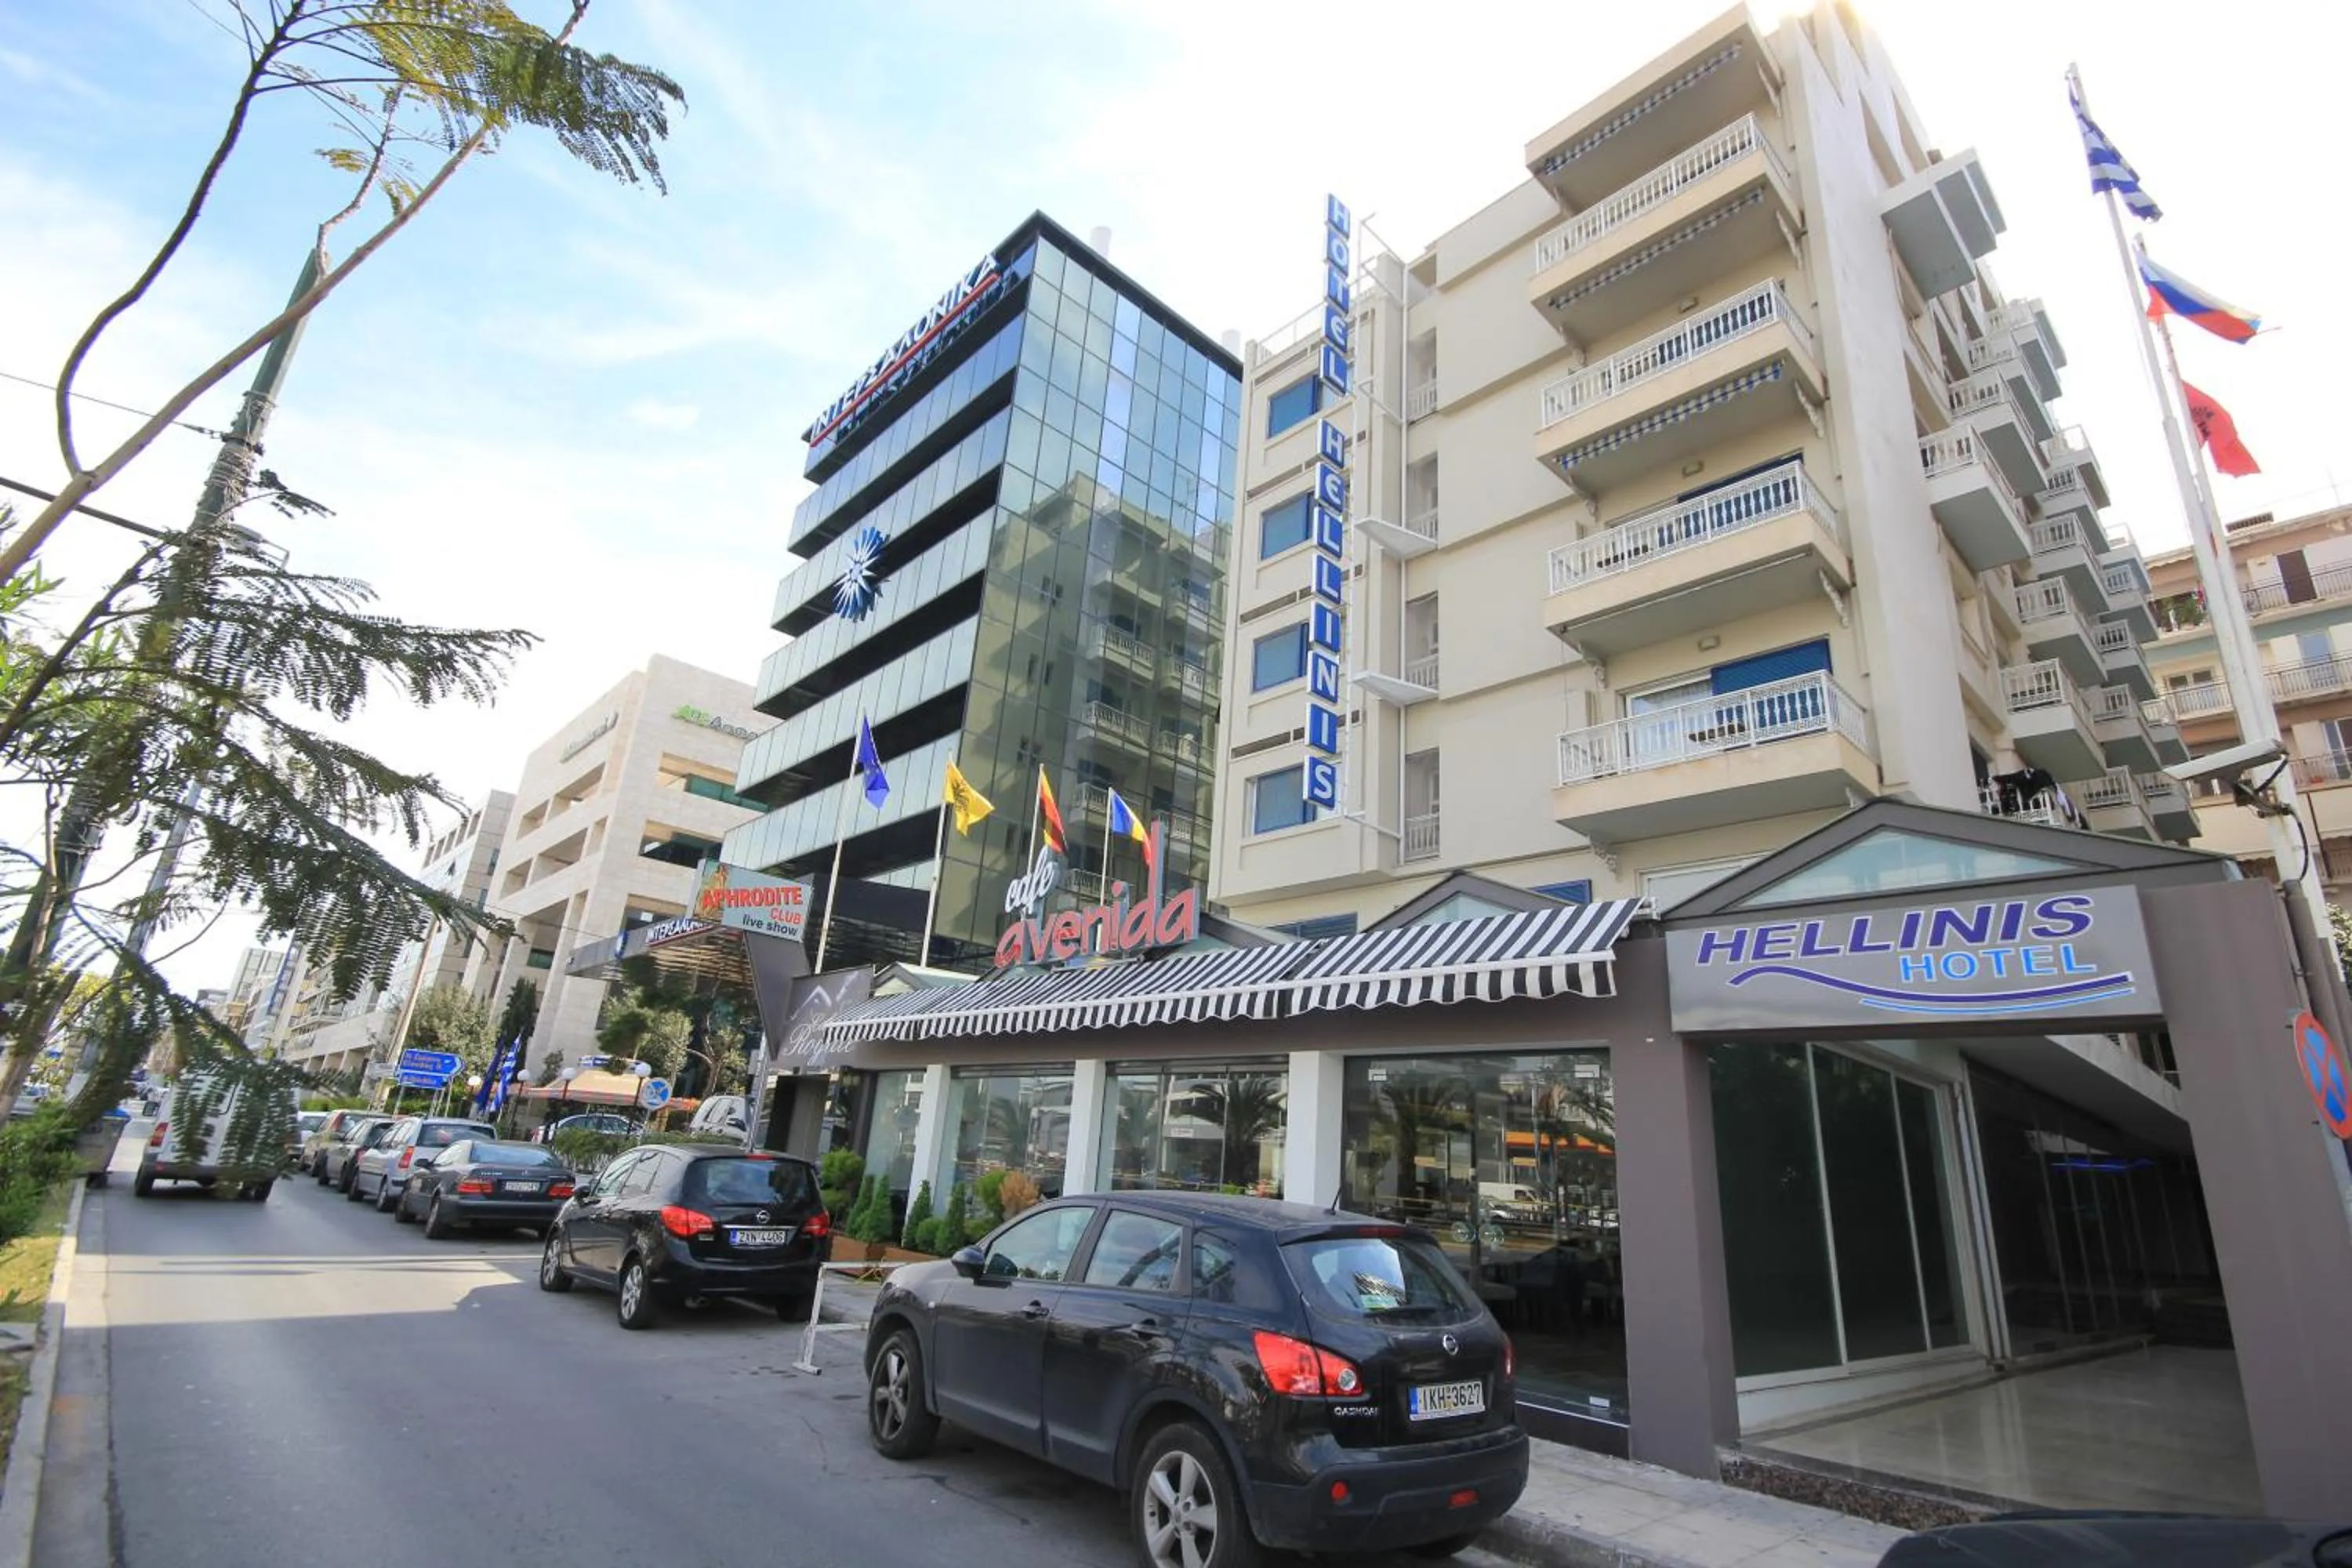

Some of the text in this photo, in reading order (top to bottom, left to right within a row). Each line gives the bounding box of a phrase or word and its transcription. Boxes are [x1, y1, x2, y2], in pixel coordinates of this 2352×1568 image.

[1309, 194, 1350, 806] HOTEL HELLINIS
[702, 886, 804, 910] APHRODITE
[993, 818, 1196, 968] avenida
[742, 913, 798, 936] live show
[770, 907, 802, 924] CLUB
[1695, 894, 2094, 967] HELLINIS
[1899, 943, 2097, 984] HOTEL
